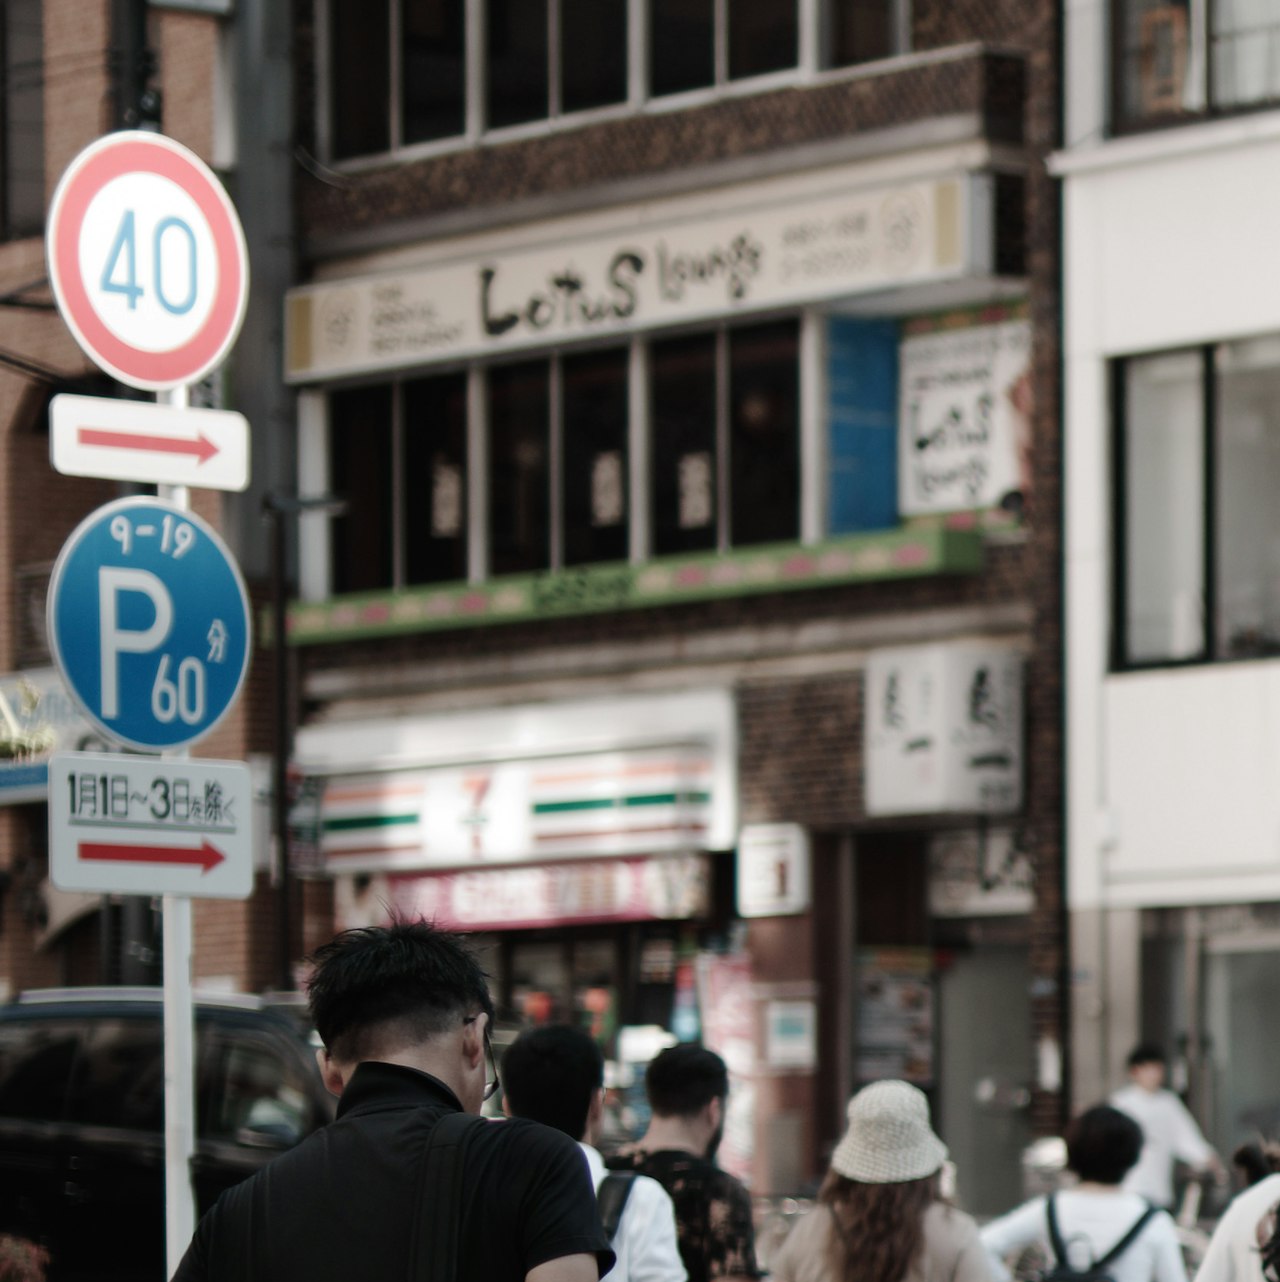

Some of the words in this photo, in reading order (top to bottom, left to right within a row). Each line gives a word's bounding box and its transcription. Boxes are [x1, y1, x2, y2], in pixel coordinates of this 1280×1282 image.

[101, 208, 198, 315] 40
[109, 514, 196, 560] 9-19
[98, 565, 174, 720] P
[151, 653, 207, 726] 60
[207, 618, 229, 664] 分
